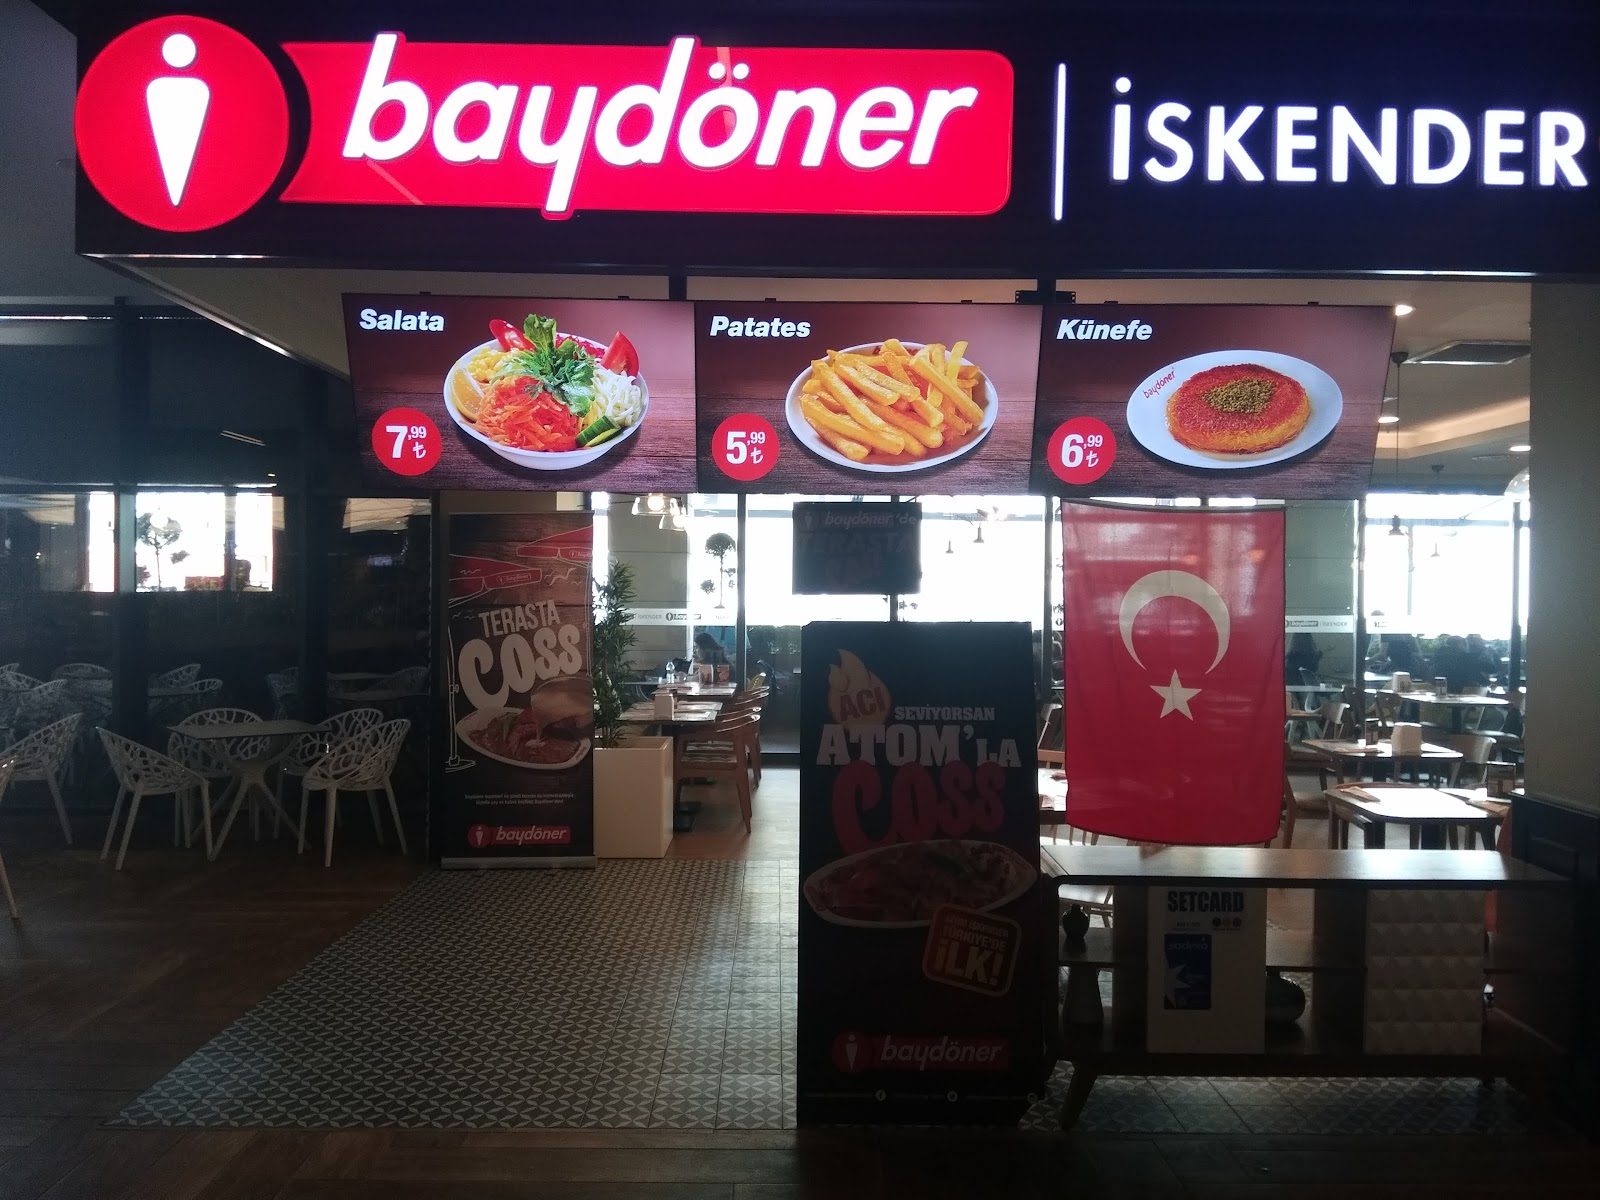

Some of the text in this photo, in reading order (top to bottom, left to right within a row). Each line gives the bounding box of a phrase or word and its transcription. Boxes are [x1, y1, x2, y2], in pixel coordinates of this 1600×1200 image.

[343, 31, 979, 214] baydöner
[1111, 76, 1589, 188] İSKENDER
[359, 308, 445, 332] Salata
[709, 315, 812, 338] Patates
[1056, 319, 1153, 341] Künefe
[479, 599, 561, 638] TERASTA
[458, 623, 584, 708] COSS
[839, 687, 995, 721] ACI SEVİYORSAN
[831, 759, 1006, 855] COSS
[496, 825, 567, 846] baydöner
[1167, 890, 1245, 913] SETCARD
[880, 1034, 1002, 1072] baydöner
